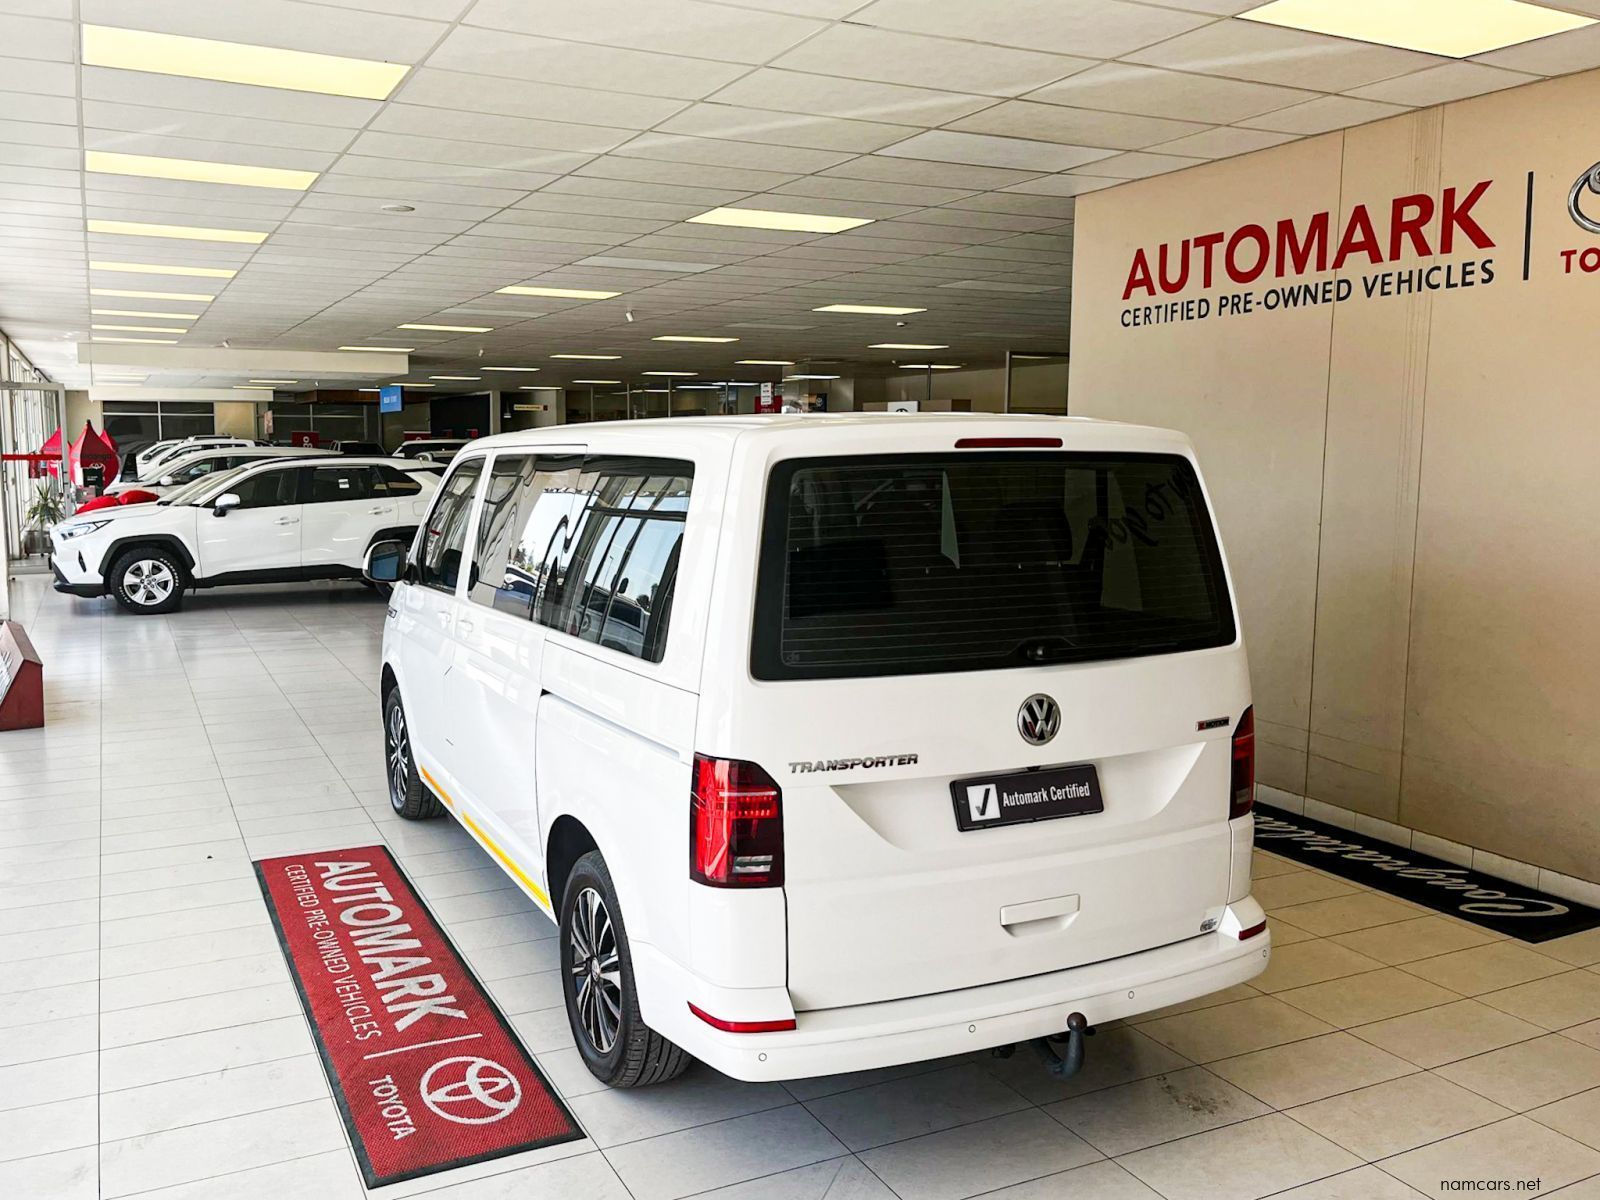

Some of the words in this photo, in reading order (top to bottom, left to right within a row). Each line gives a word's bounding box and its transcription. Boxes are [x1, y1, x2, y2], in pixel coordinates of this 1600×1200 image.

[1122, 180, 1496, 300] AUTOMARK
[1121, 298, 1210, 327] CERTIFIED
[1218, 278, 1352, 316] PRE-OWNED
[1362, 259, 1495, 298] VEHICLES
[789, 754, 918, 773] TRANSPORTER
[1003, 788, 1049, 807] Automark
[1050, 782, 1090, 801] Certified
[284, 864, 320, 908] CERTIFIED
[304, 908, 350, 974] PRE-OWNED
[333, 974, 382, 1041] VEHICLES
[314, 861, 468, 1032] AUTOMARK
[369, 1074, 417, 1140] TOYOTA
